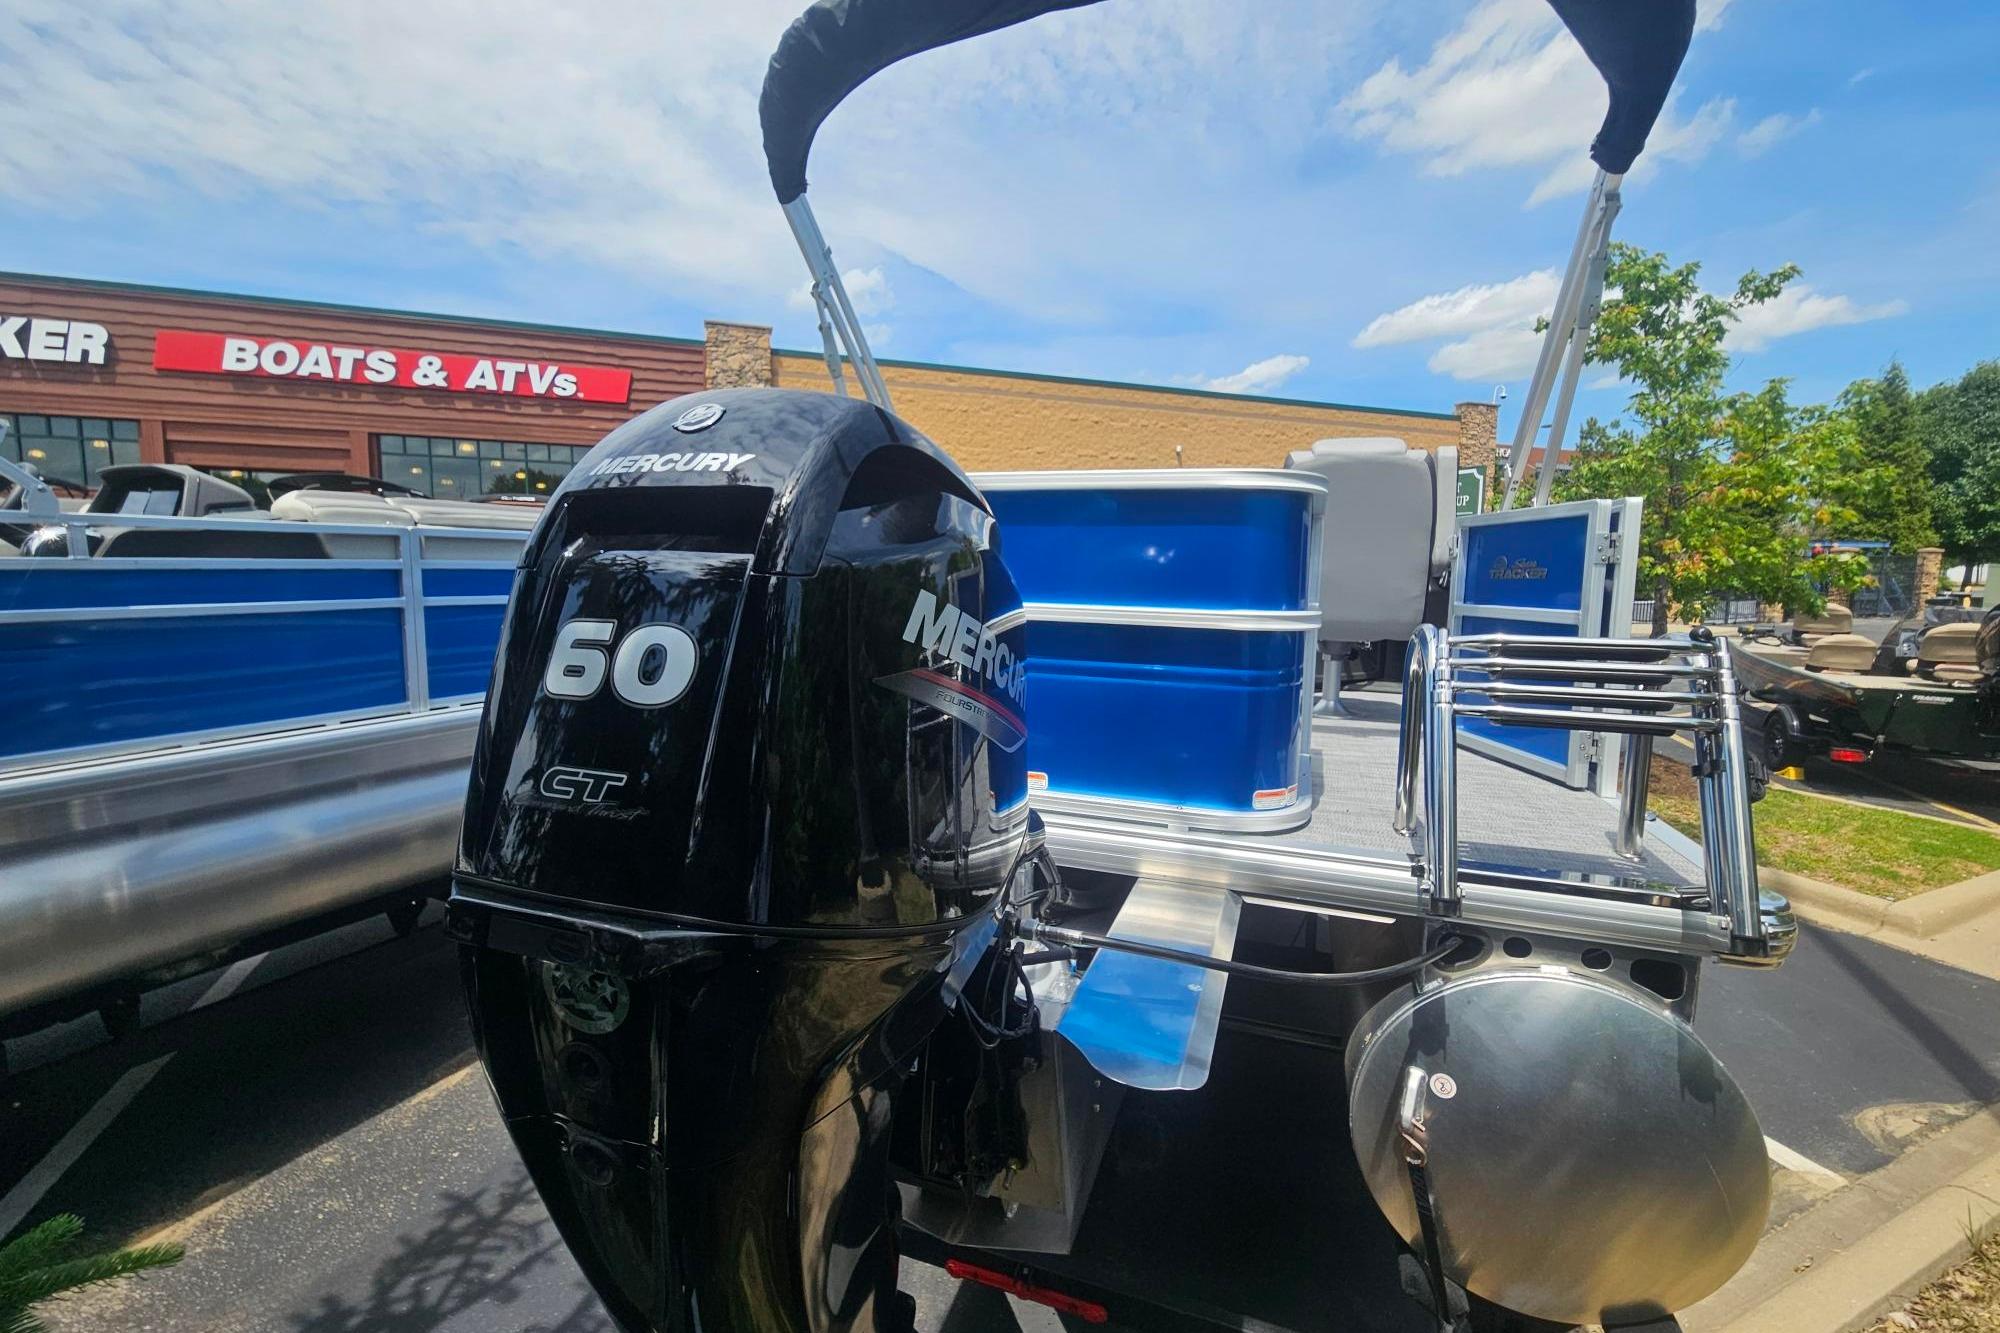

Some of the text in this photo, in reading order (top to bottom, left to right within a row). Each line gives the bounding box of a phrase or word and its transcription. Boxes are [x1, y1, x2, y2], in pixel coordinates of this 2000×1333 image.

[221, 338, 397, 384] BOATS
[411, 355, 448, 387] &
[589, 452, 756, 477] MERCURY
[544, 617, 700, 710] 60
[902, 588, 1028, 712] MERCUR
